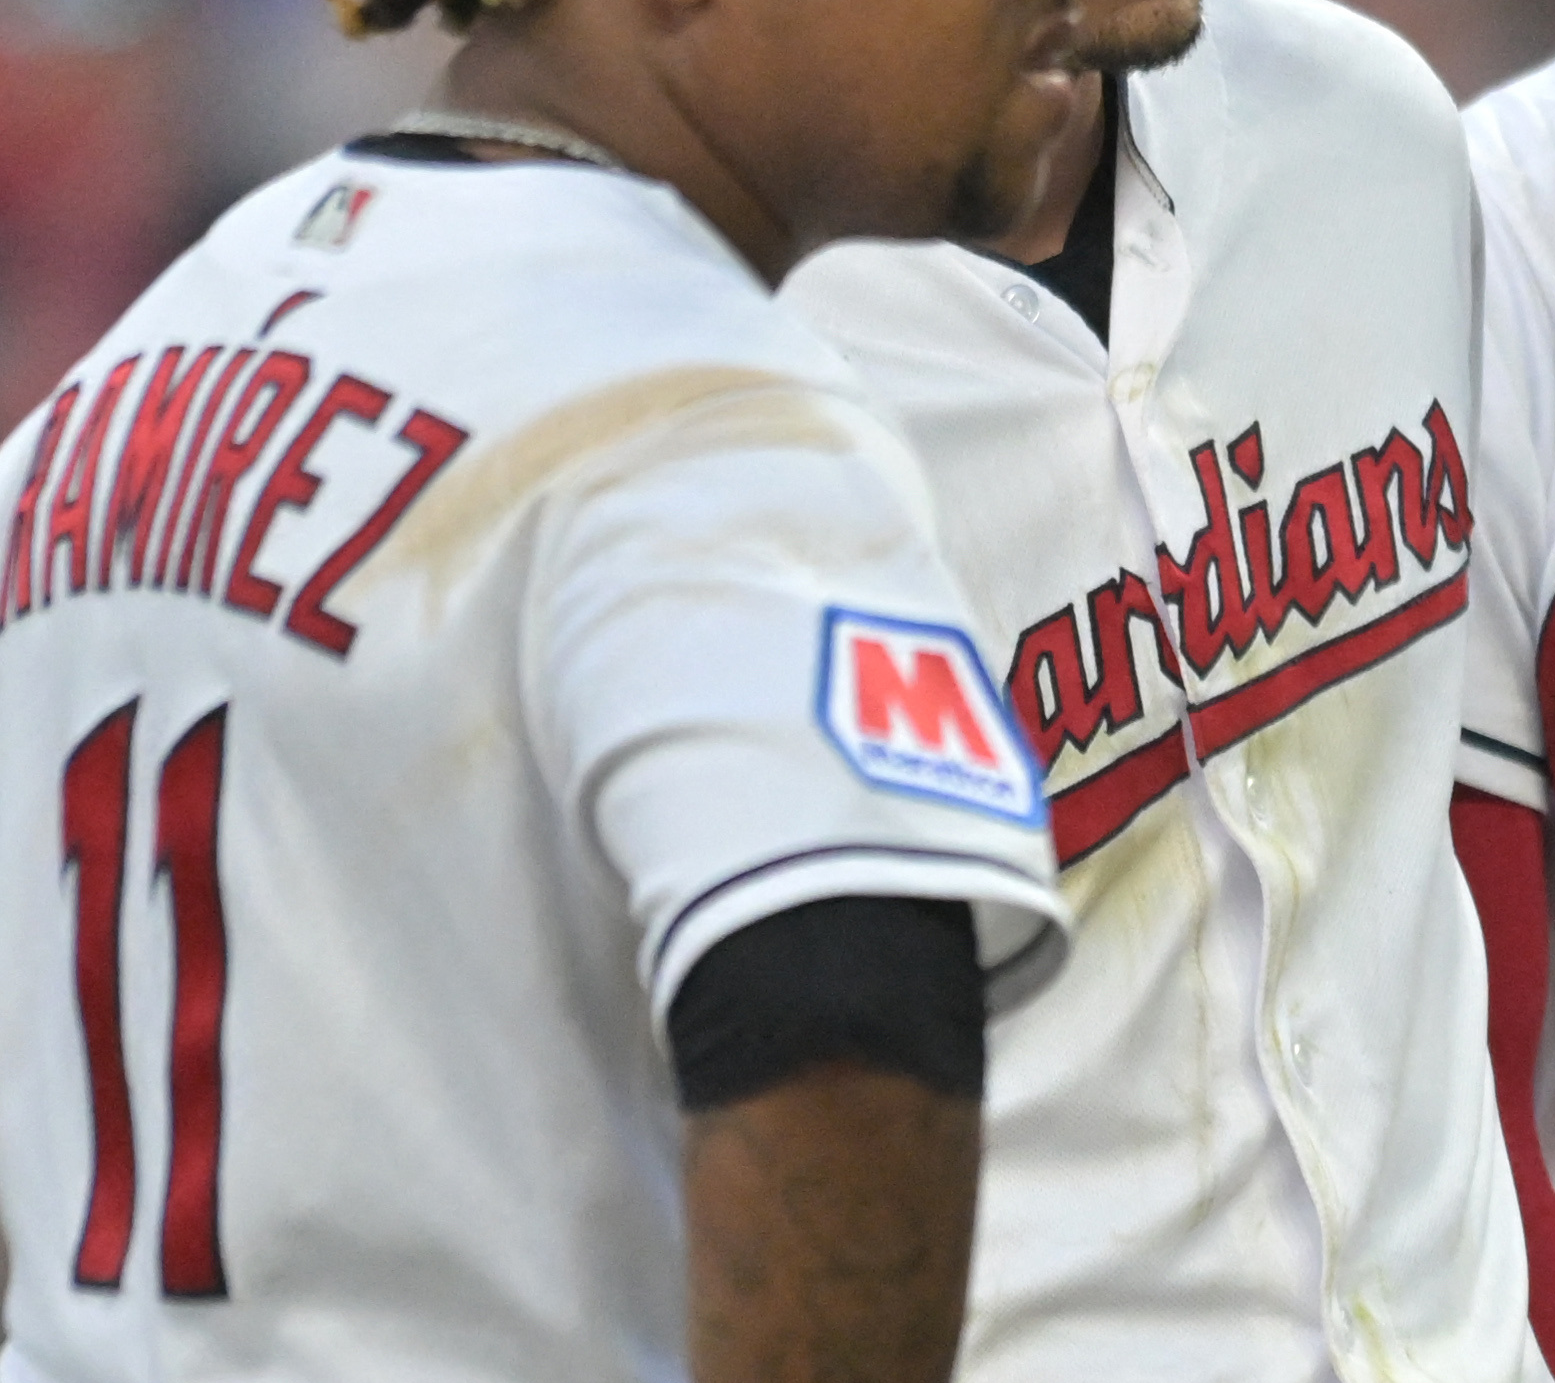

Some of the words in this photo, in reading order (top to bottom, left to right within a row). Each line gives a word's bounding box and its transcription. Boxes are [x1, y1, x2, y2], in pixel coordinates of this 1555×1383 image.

[0, 286, 470, 665] RAMÍREZ
[1003, 397, 1475, 782] ardians
[851, 637, 1000, 769] M
[61, 695, 229, 1302] 11
